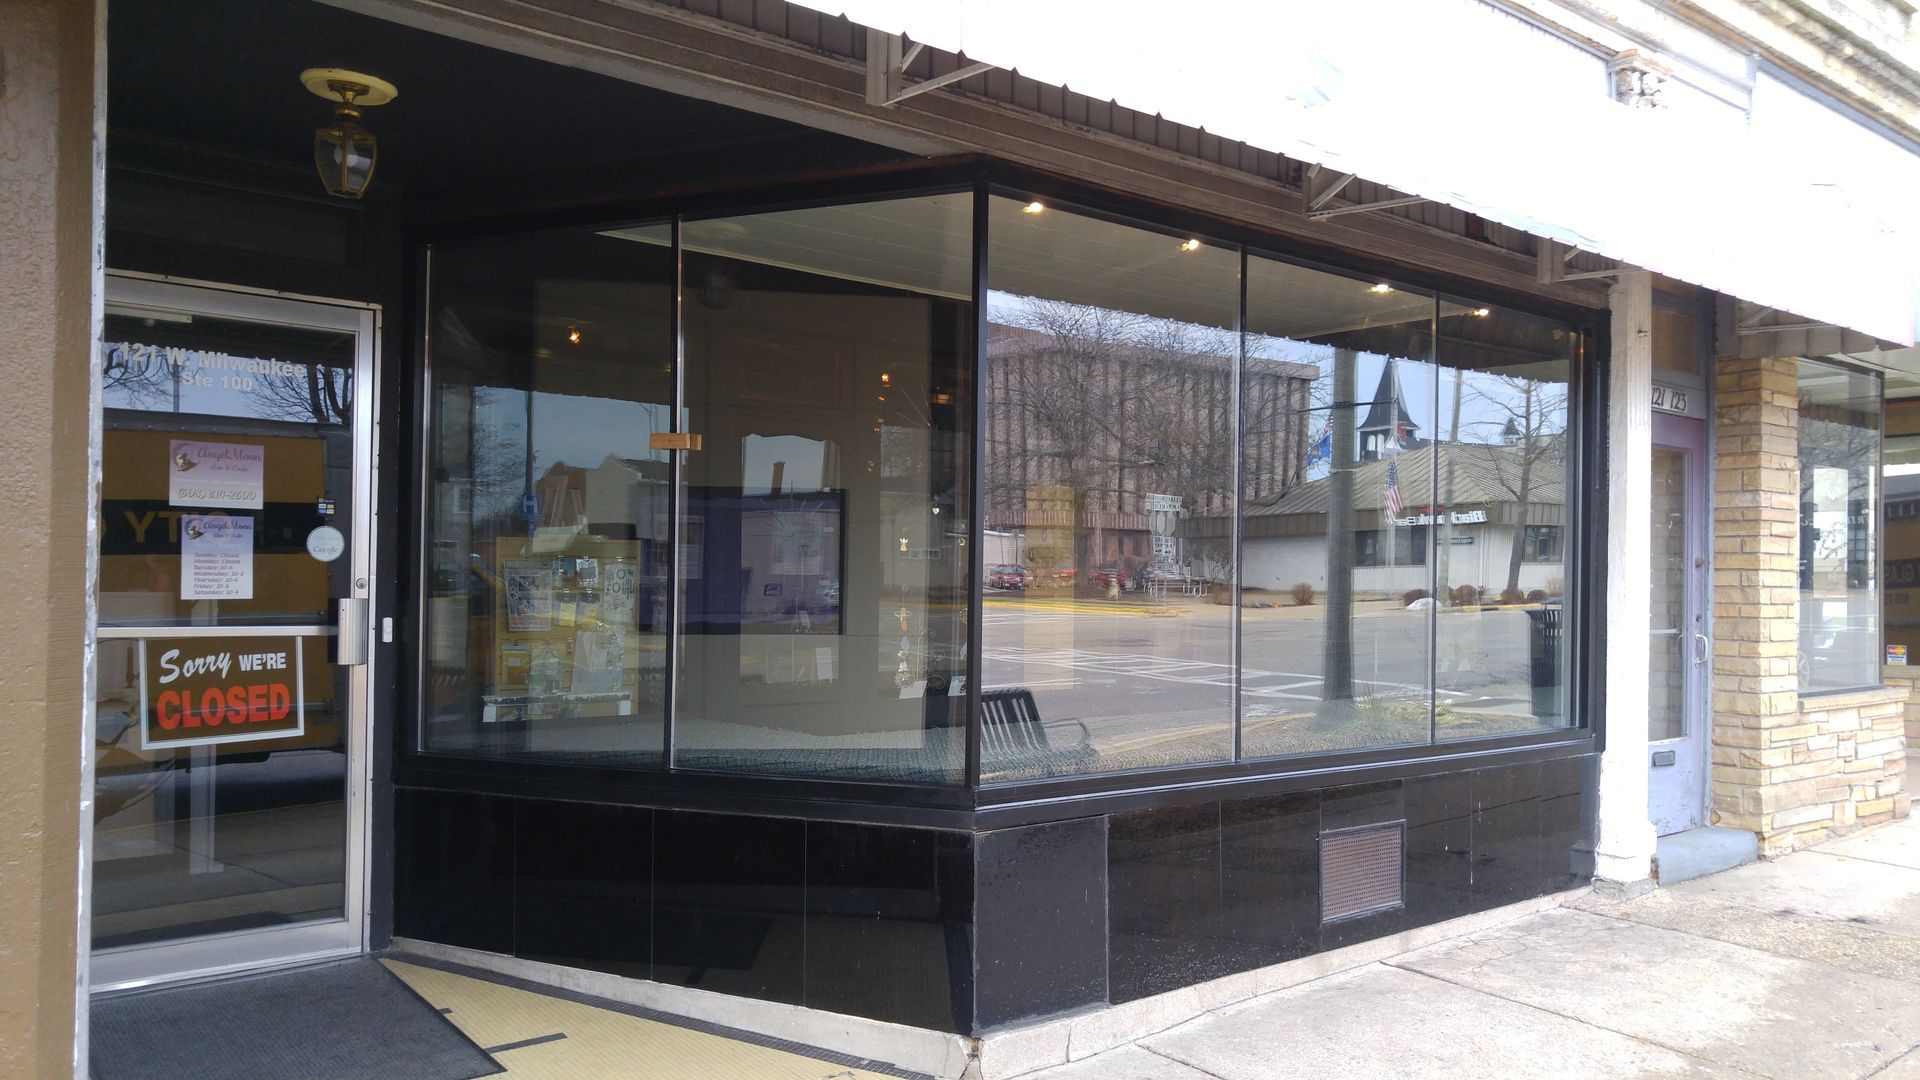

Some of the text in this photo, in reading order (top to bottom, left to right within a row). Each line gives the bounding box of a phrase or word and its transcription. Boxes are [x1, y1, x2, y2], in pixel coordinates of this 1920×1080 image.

[120, 341, 157, 363] 121
[198, 350, 305, 378] Milwaukee
[182, 371, 253, 391] Ste 100
[1671, 391, 1687, 412] 123
[231, 447, 261, 461] Moon
[159, 648, 287, 685] Sorry WE'RE
[156, 683, 290, 730] CLOSED
